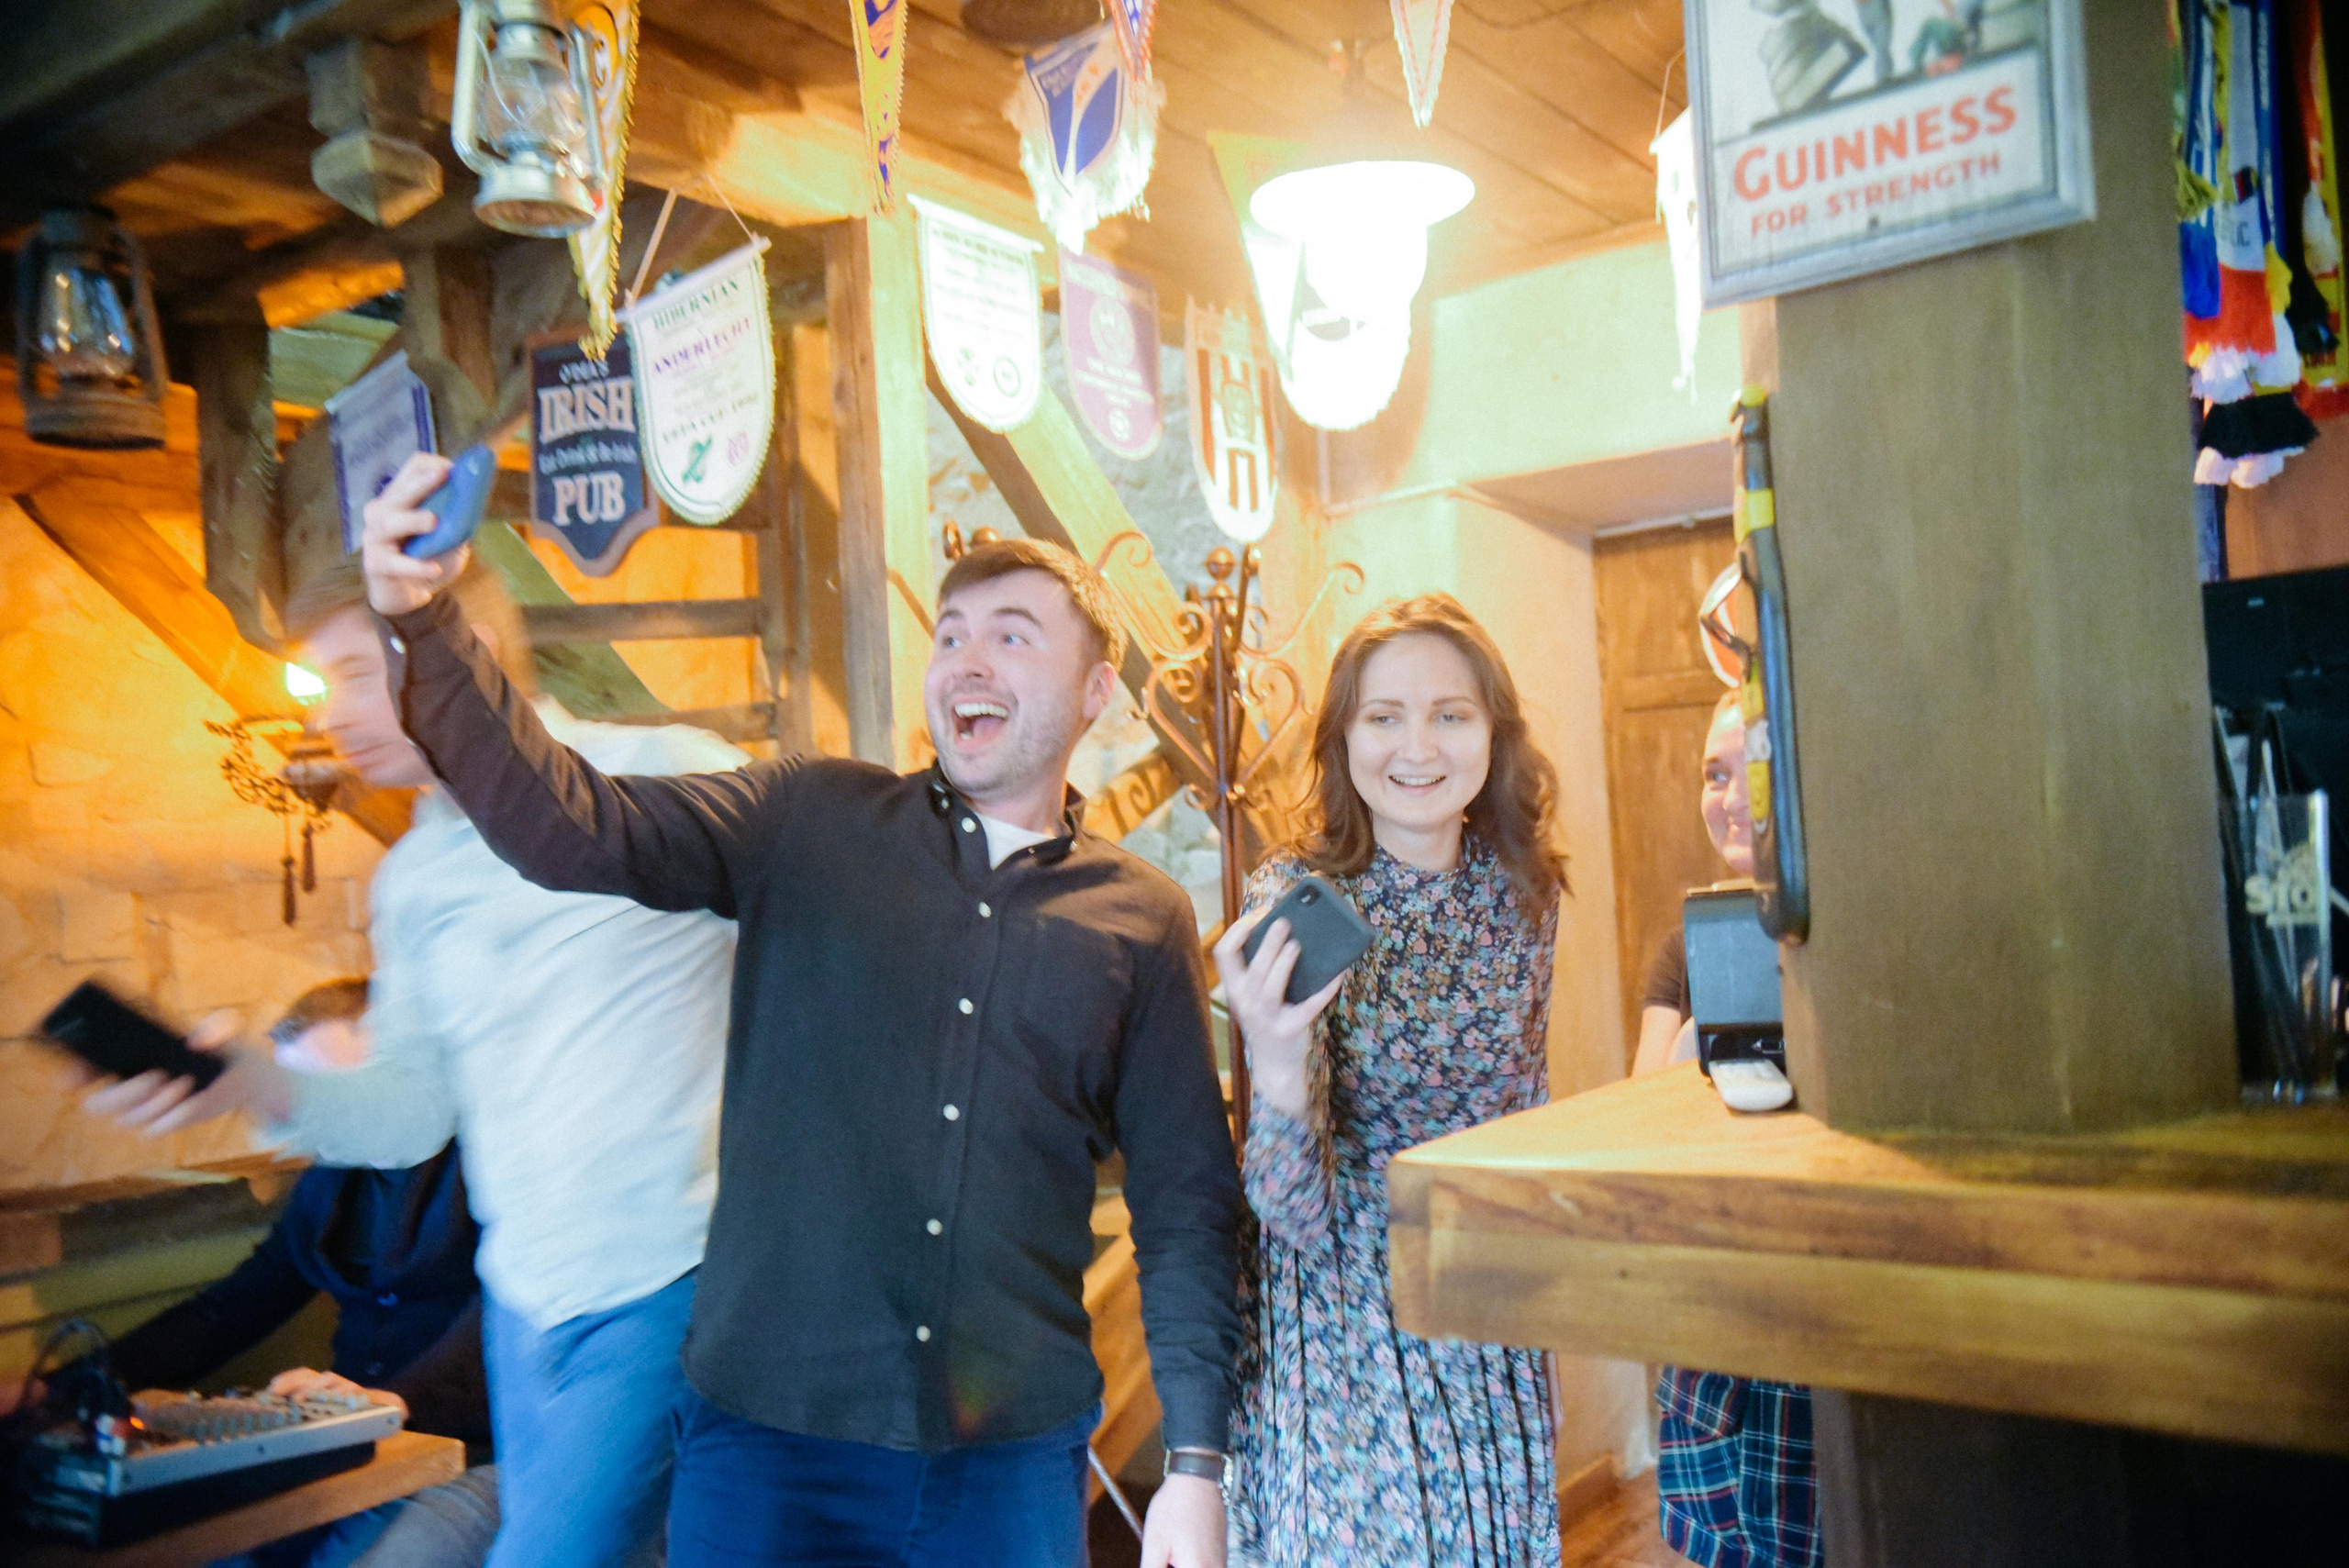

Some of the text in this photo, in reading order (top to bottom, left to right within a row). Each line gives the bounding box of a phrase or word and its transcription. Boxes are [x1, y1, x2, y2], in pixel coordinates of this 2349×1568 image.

[1734, 85, 2016, 201] GUINNESS
[1751, 151, 2000, 238] FOR STRENGTH
[538, 376, 636, 445] IRISH
[551, 471, 626, 527] PUB
